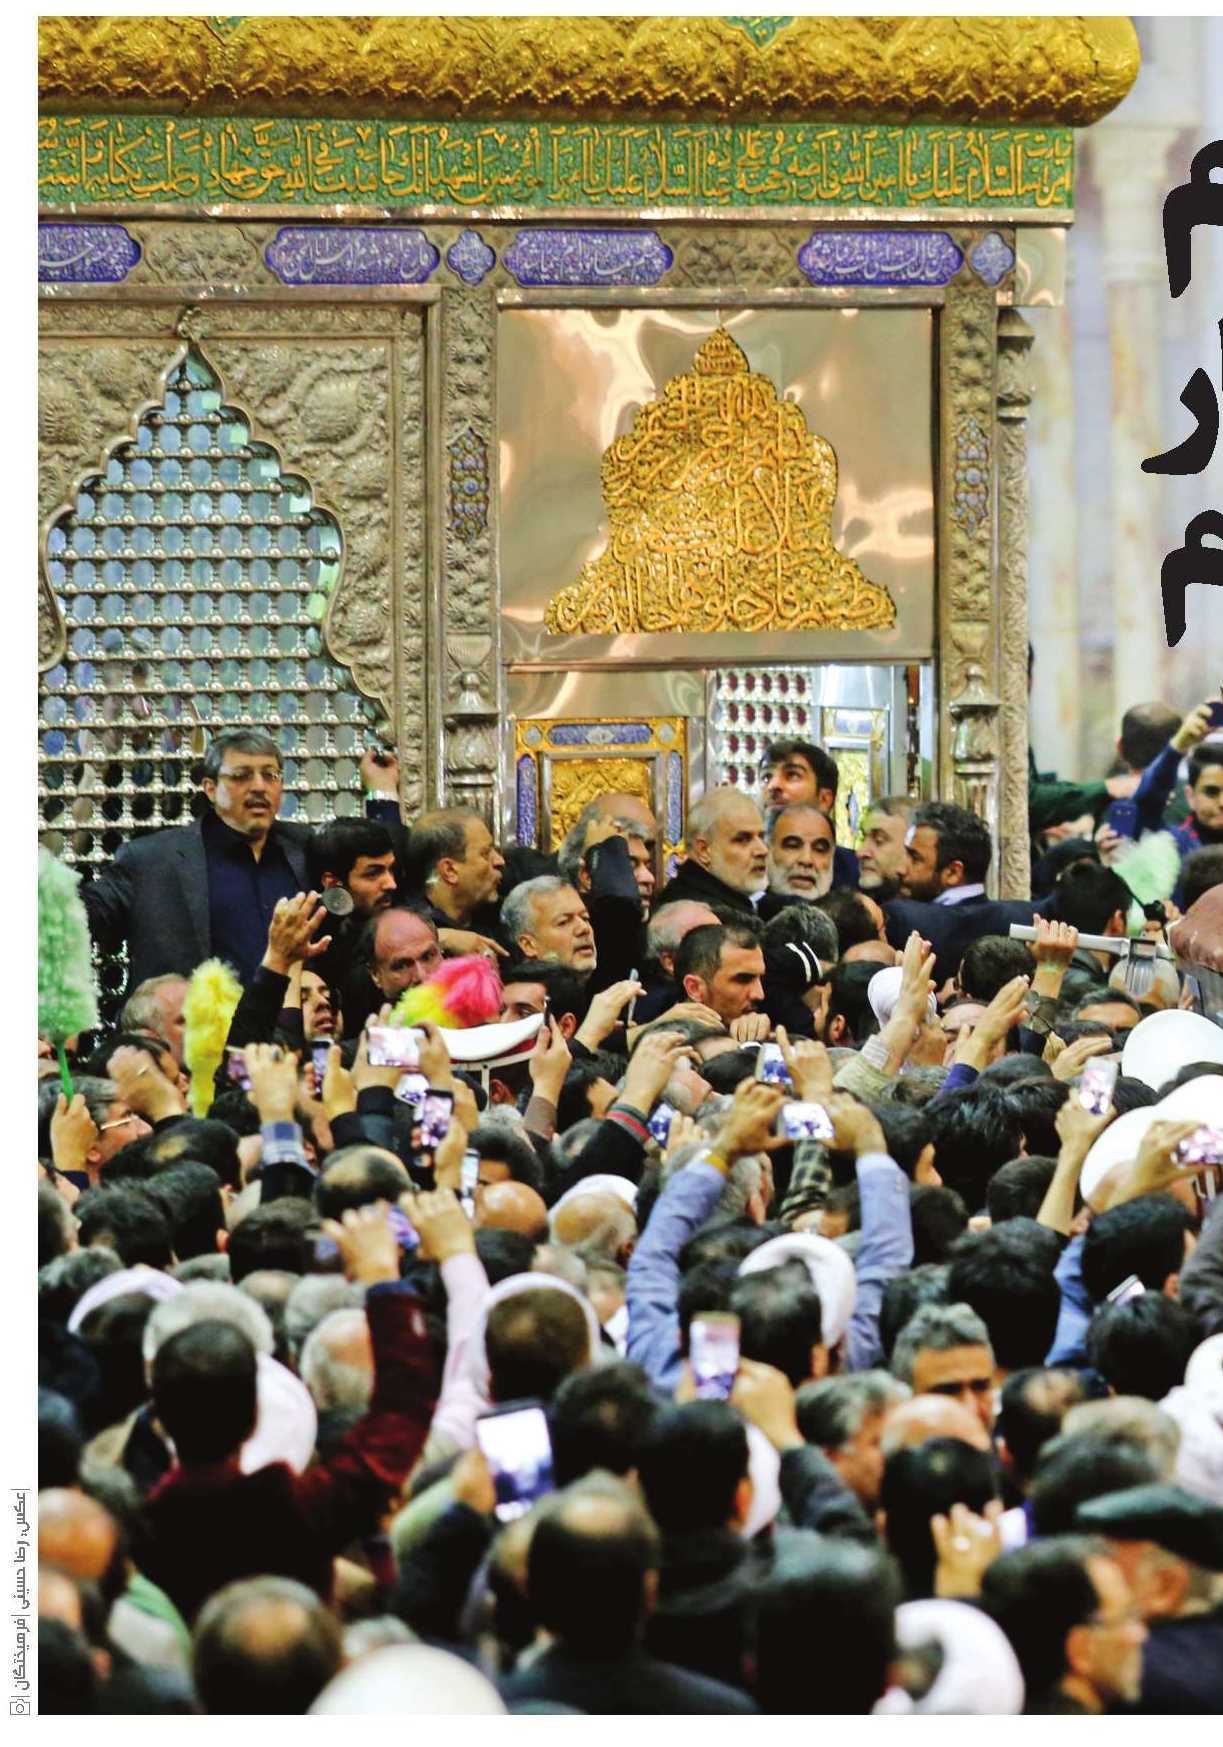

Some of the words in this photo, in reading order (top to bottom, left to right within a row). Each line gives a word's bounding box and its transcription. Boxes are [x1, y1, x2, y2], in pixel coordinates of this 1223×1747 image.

[13, 1540, 30, 1563] رضا
[12, 1566, 31, 1610] حسینی
[12, 1618, 31, 1691] فرهیختگان
